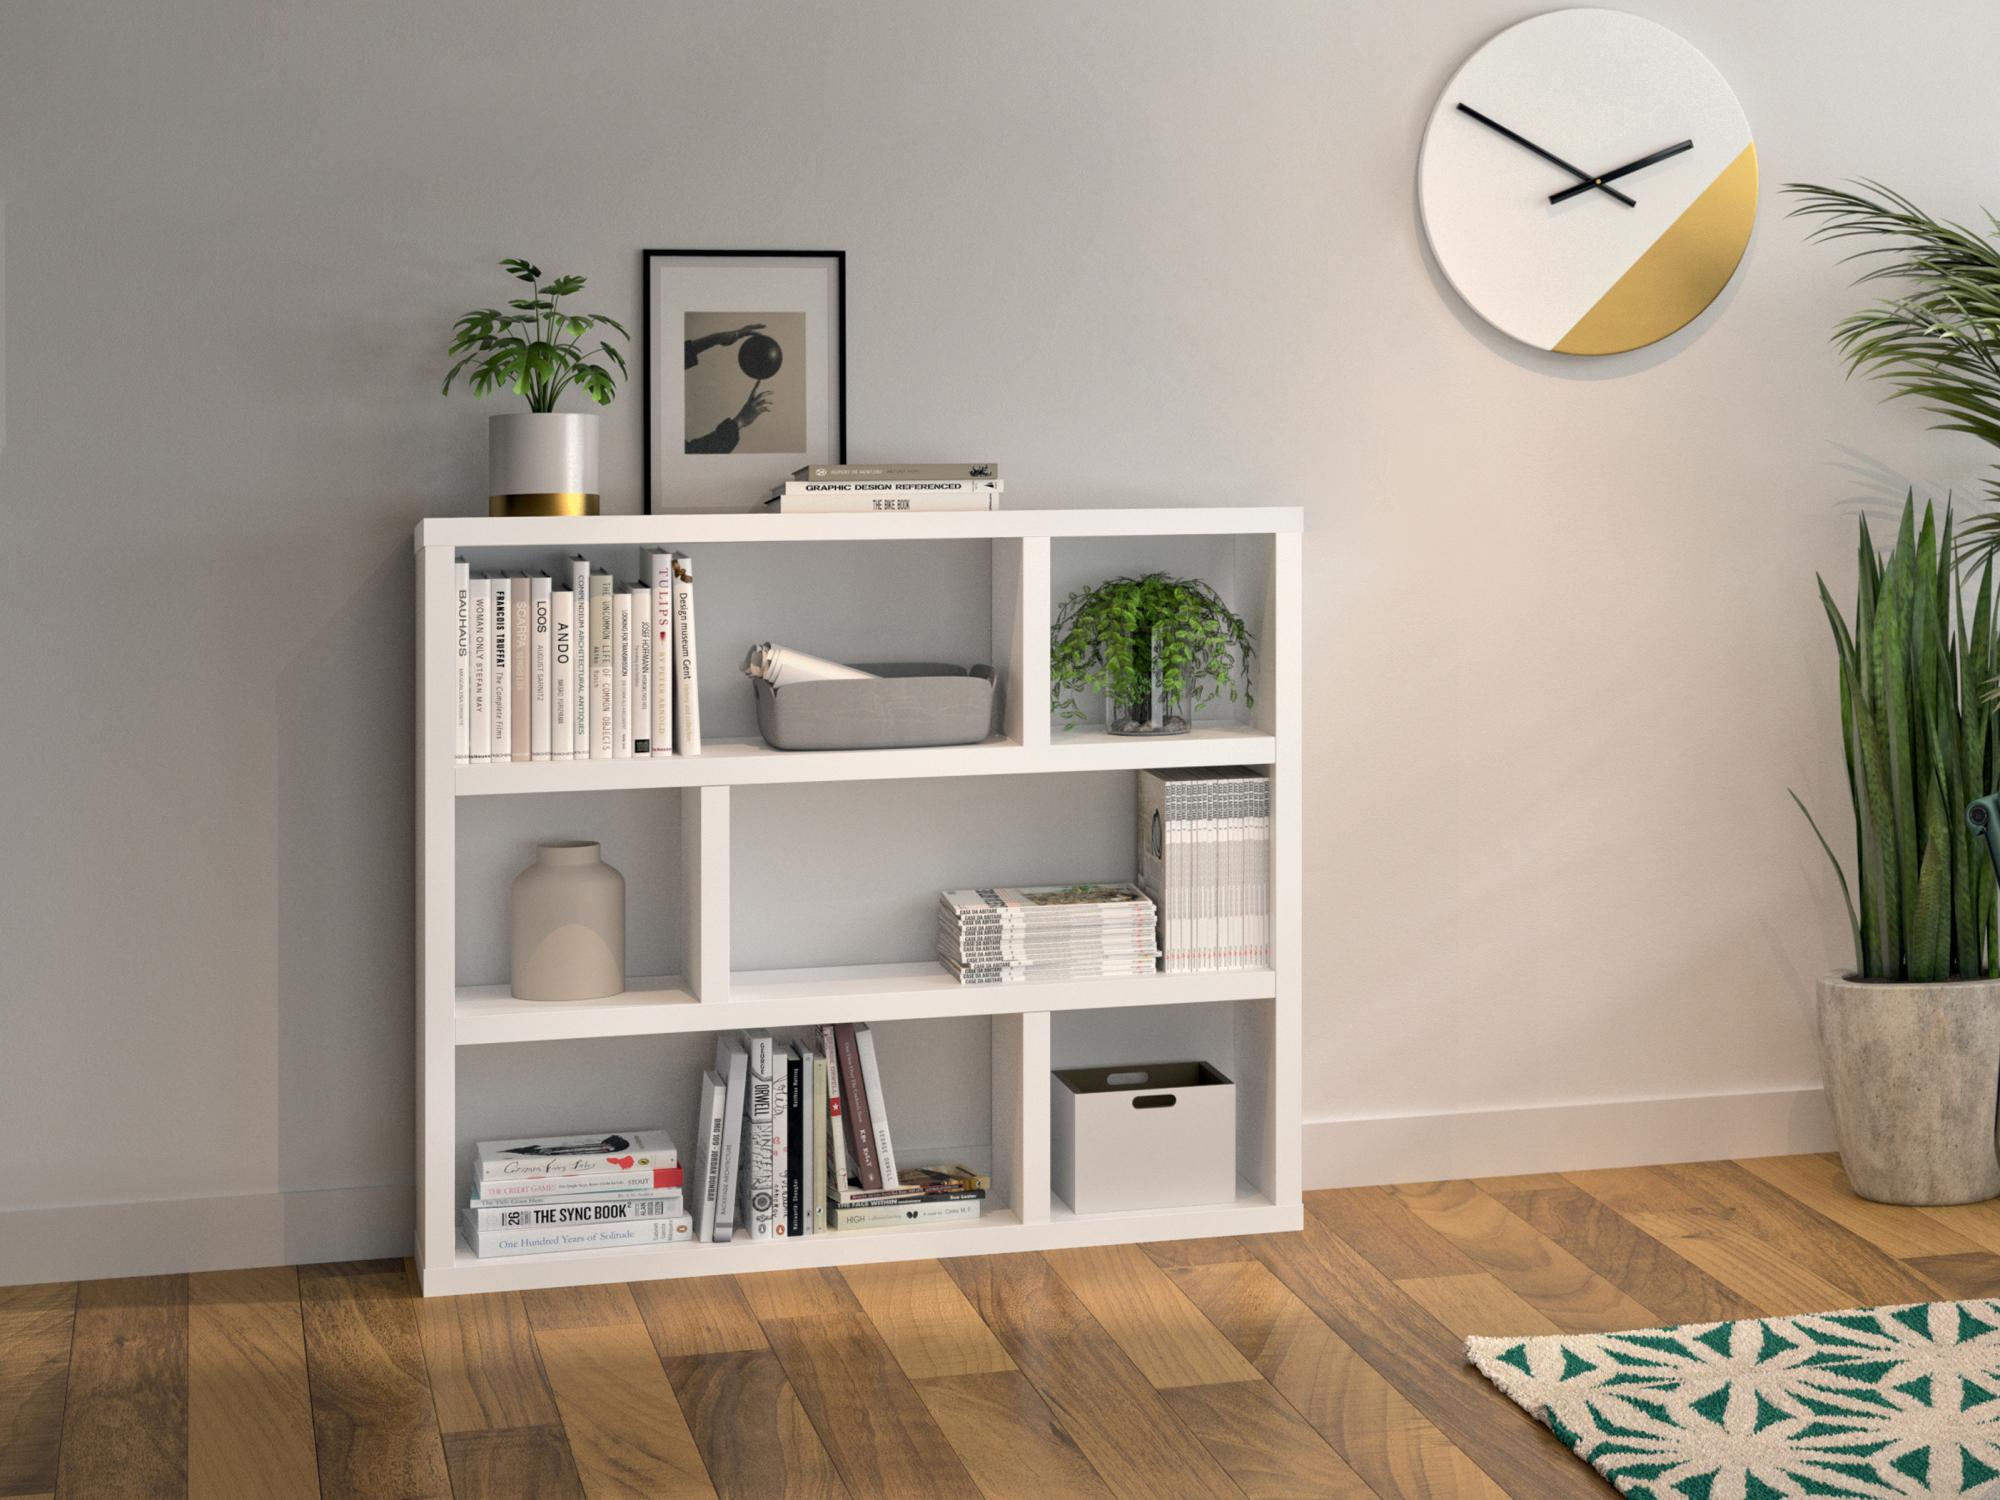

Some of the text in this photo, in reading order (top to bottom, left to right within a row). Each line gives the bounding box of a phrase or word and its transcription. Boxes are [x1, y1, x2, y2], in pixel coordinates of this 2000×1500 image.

[602, 583, 610, 596] THE
[658, 568, 668, 626] TULIPS
[476, 598, 484, 634] WOMAN
[496, 591, 505, 631] FRANCOIS
[537, 600, 547, 633] LOOS
[602, 601, 610, 640] UNCOMMON
[678, 593, 688, 621] Design
[458, 590, 467, 657] BAUHAUS
[516, 601, 526, 648] SCARPA
[475, 636, 484, 660] ONLY
[496, 634, 505, 668] TRUFFAT
[557, 622, 568, 664] ANDO
[602, 669, 610, 678] OF
[682, 659, 691, 680] Gent
[495, 687, 504, 720] Complete
[602, 683, 610, 712] COMMON
[496, 722, 504, 740] Films
[602, 717, 610, 751] OBJECTS
[755, 1084, 770, 1116] ORWELL
[879, 1130, 893, 1181] GEORGE ORWELL
[508, 1212, 520, 1226] 26
[534, 1209, 556, 1224] THE
[559, 1207, 592, 1222] SYNC
[847, 1216, 865, 1224] HIGH
[498, 1230, 635, 1249] One Hundred Years of Solitude
